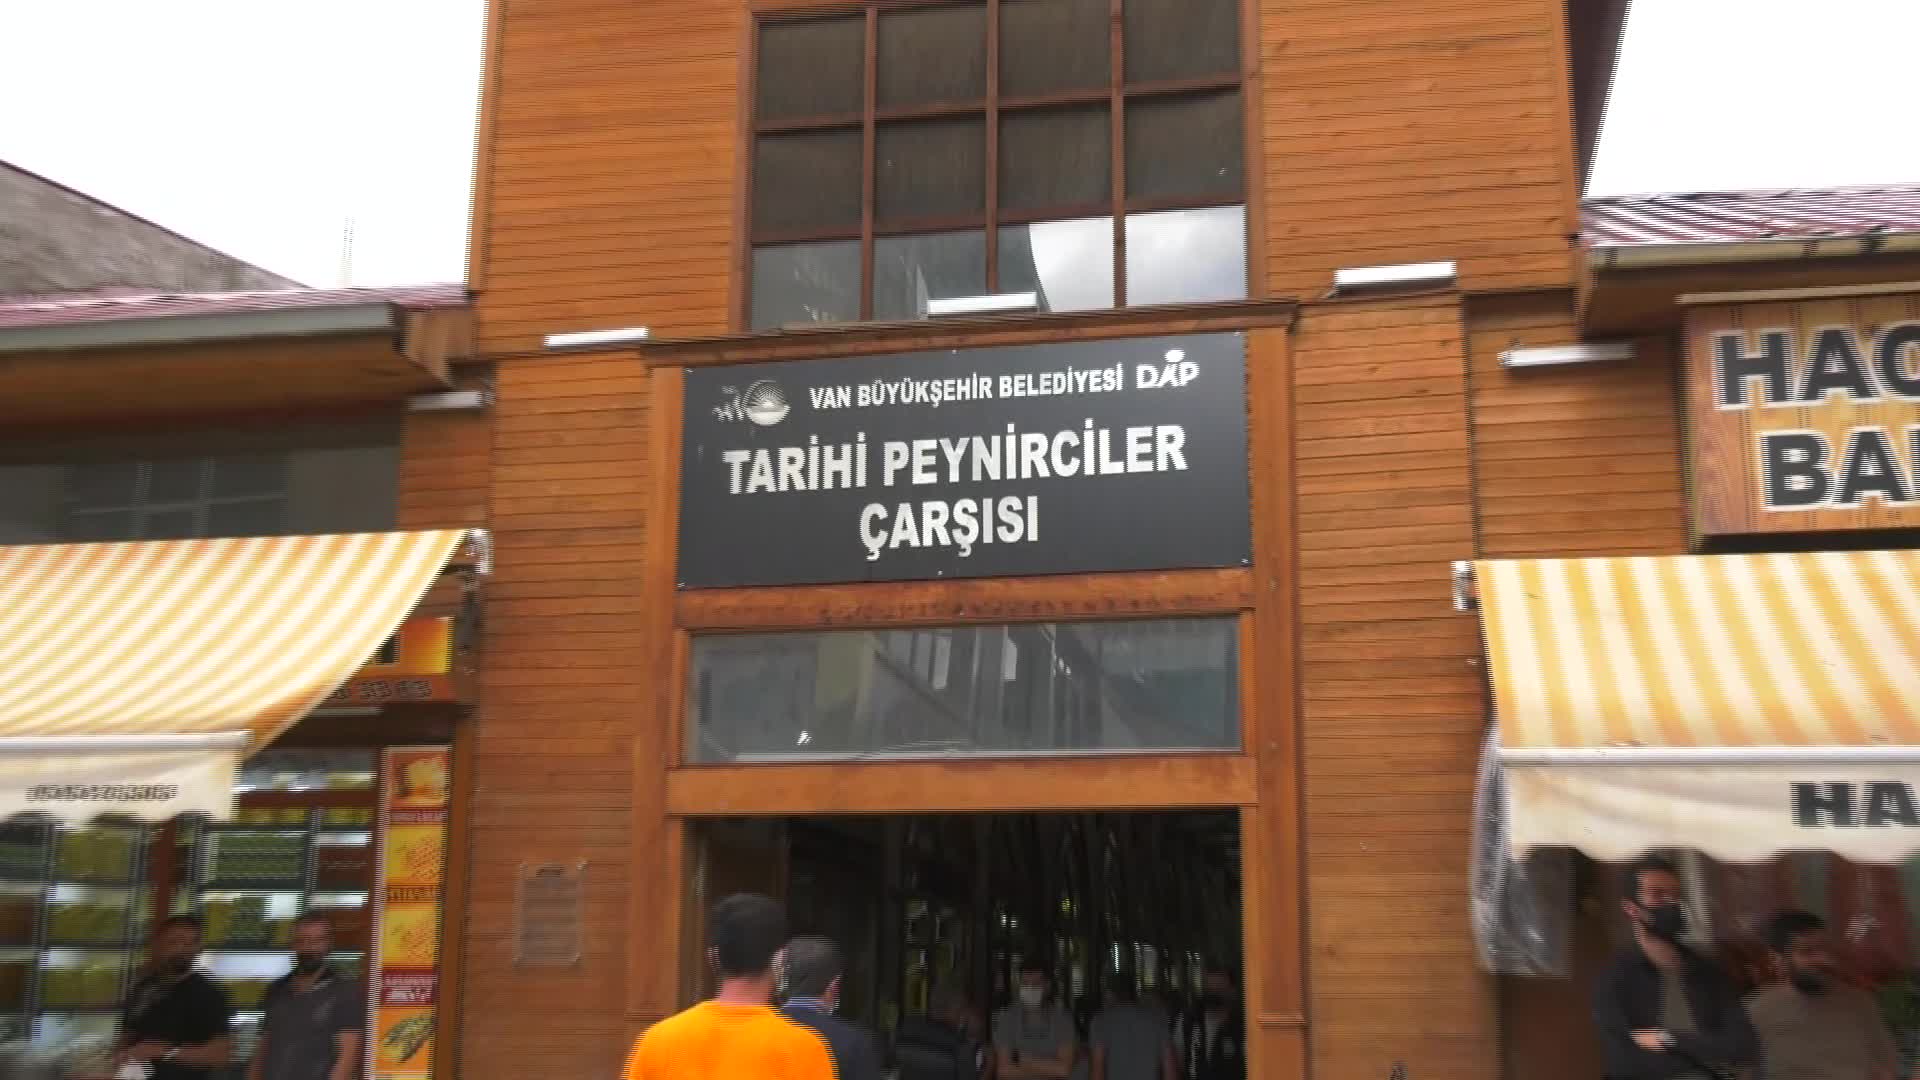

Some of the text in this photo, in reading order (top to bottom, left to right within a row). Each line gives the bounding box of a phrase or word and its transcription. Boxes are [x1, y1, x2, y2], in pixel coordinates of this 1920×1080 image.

[808, 384, 853, 409] VAN
[857, 372, 993, 408] BÜYÜKŞEHİR
[999, 362, 1124, 398] BELEDİYESİ
[721, 417, 1189, 494] TARİHİ PEYNİRCİLER
[1756, 423, 1920, 511] BA
[858, 495, 1039, 561] ÇARŞISI
